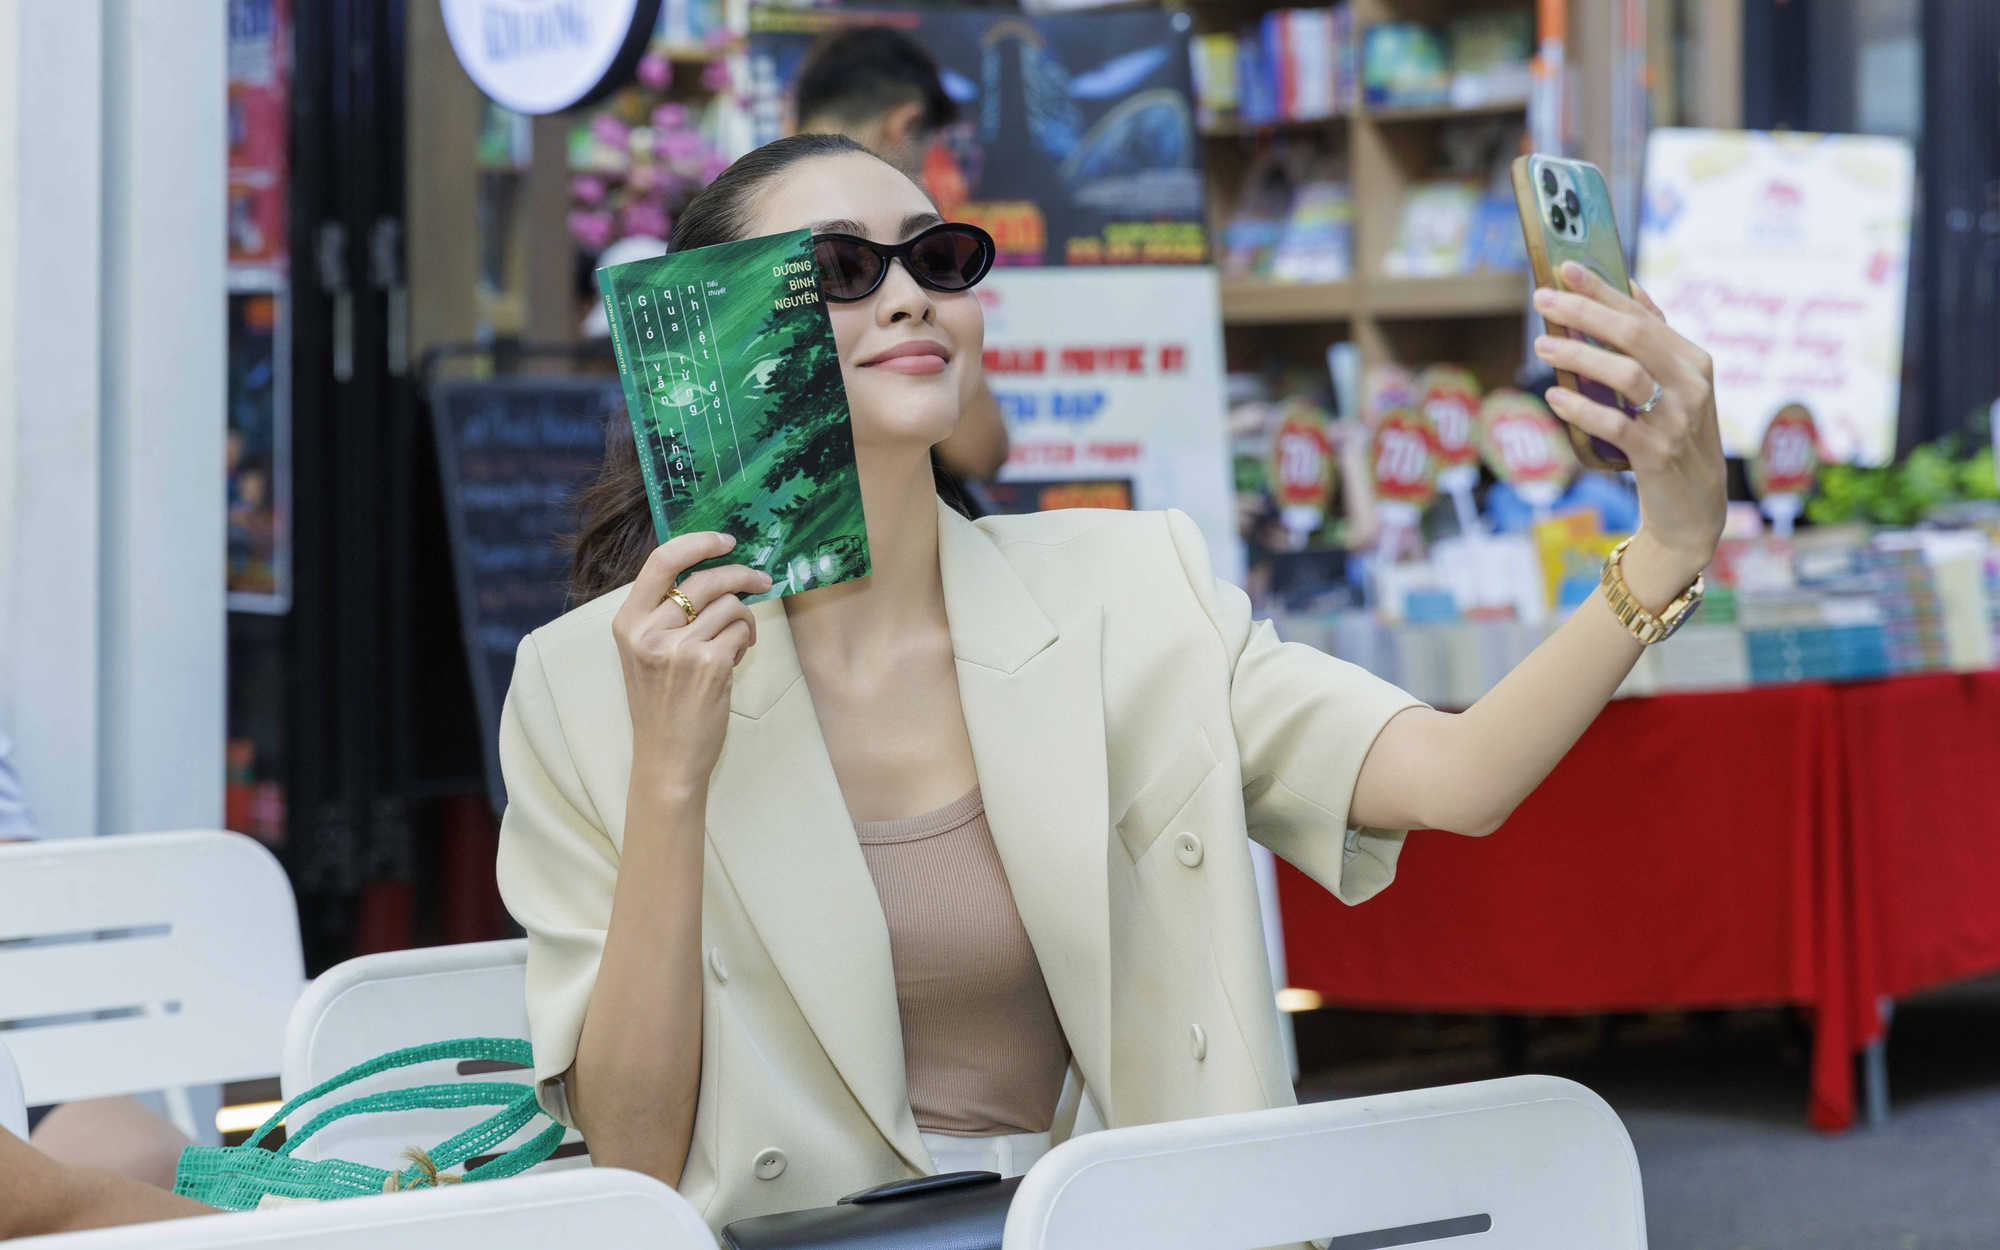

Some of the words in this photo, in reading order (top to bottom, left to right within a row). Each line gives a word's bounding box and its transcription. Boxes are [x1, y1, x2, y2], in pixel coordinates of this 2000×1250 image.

[772, 260, 812, 277] DƯƠNG
[774, 291, 819, 310] NGUYÊN
[789, 276, 816, 291] BÌNH
[663, 289, 679, 332] qua
[679, 354, 698, 416] rừng
[687, 285, 709, 359] nhiệt
[709, 380, 723, 425] đới
[638, 295, 654, 339] Gió
[653, 363, 669, 405] vẫn
[669, 427, 686, 487] thổi
